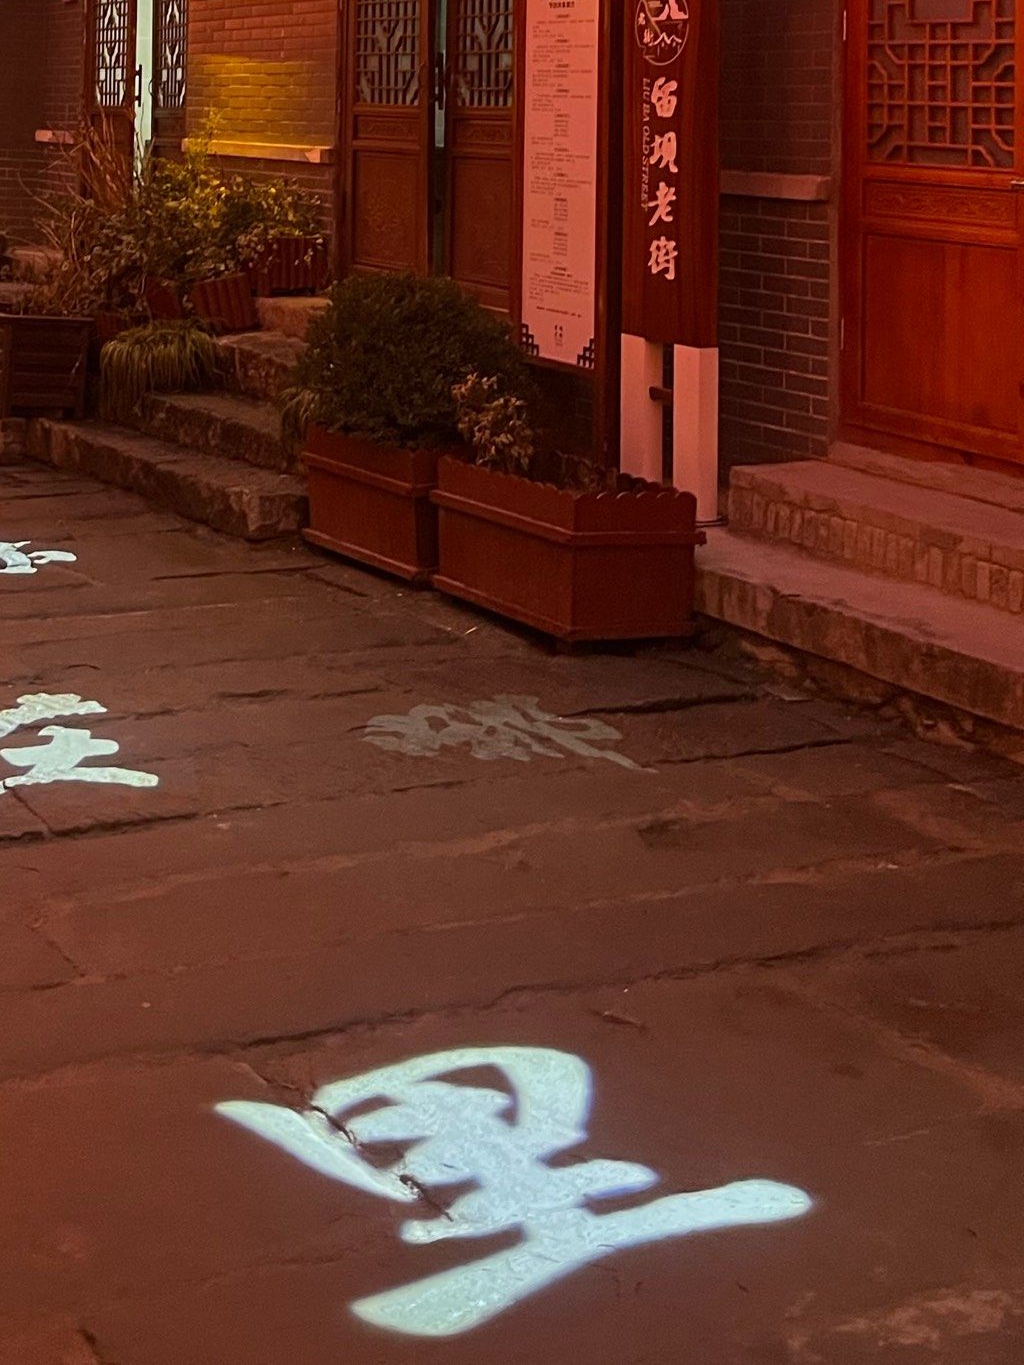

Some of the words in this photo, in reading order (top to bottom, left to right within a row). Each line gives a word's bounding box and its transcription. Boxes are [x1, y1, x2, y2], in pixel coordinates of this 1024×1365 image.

[642, 77, 651, 102] LIU
[642, 125, 650, 155] OLD
[648, 76, 678, 280] 留坝老街
[213, 1046, 814, 1337] 里
